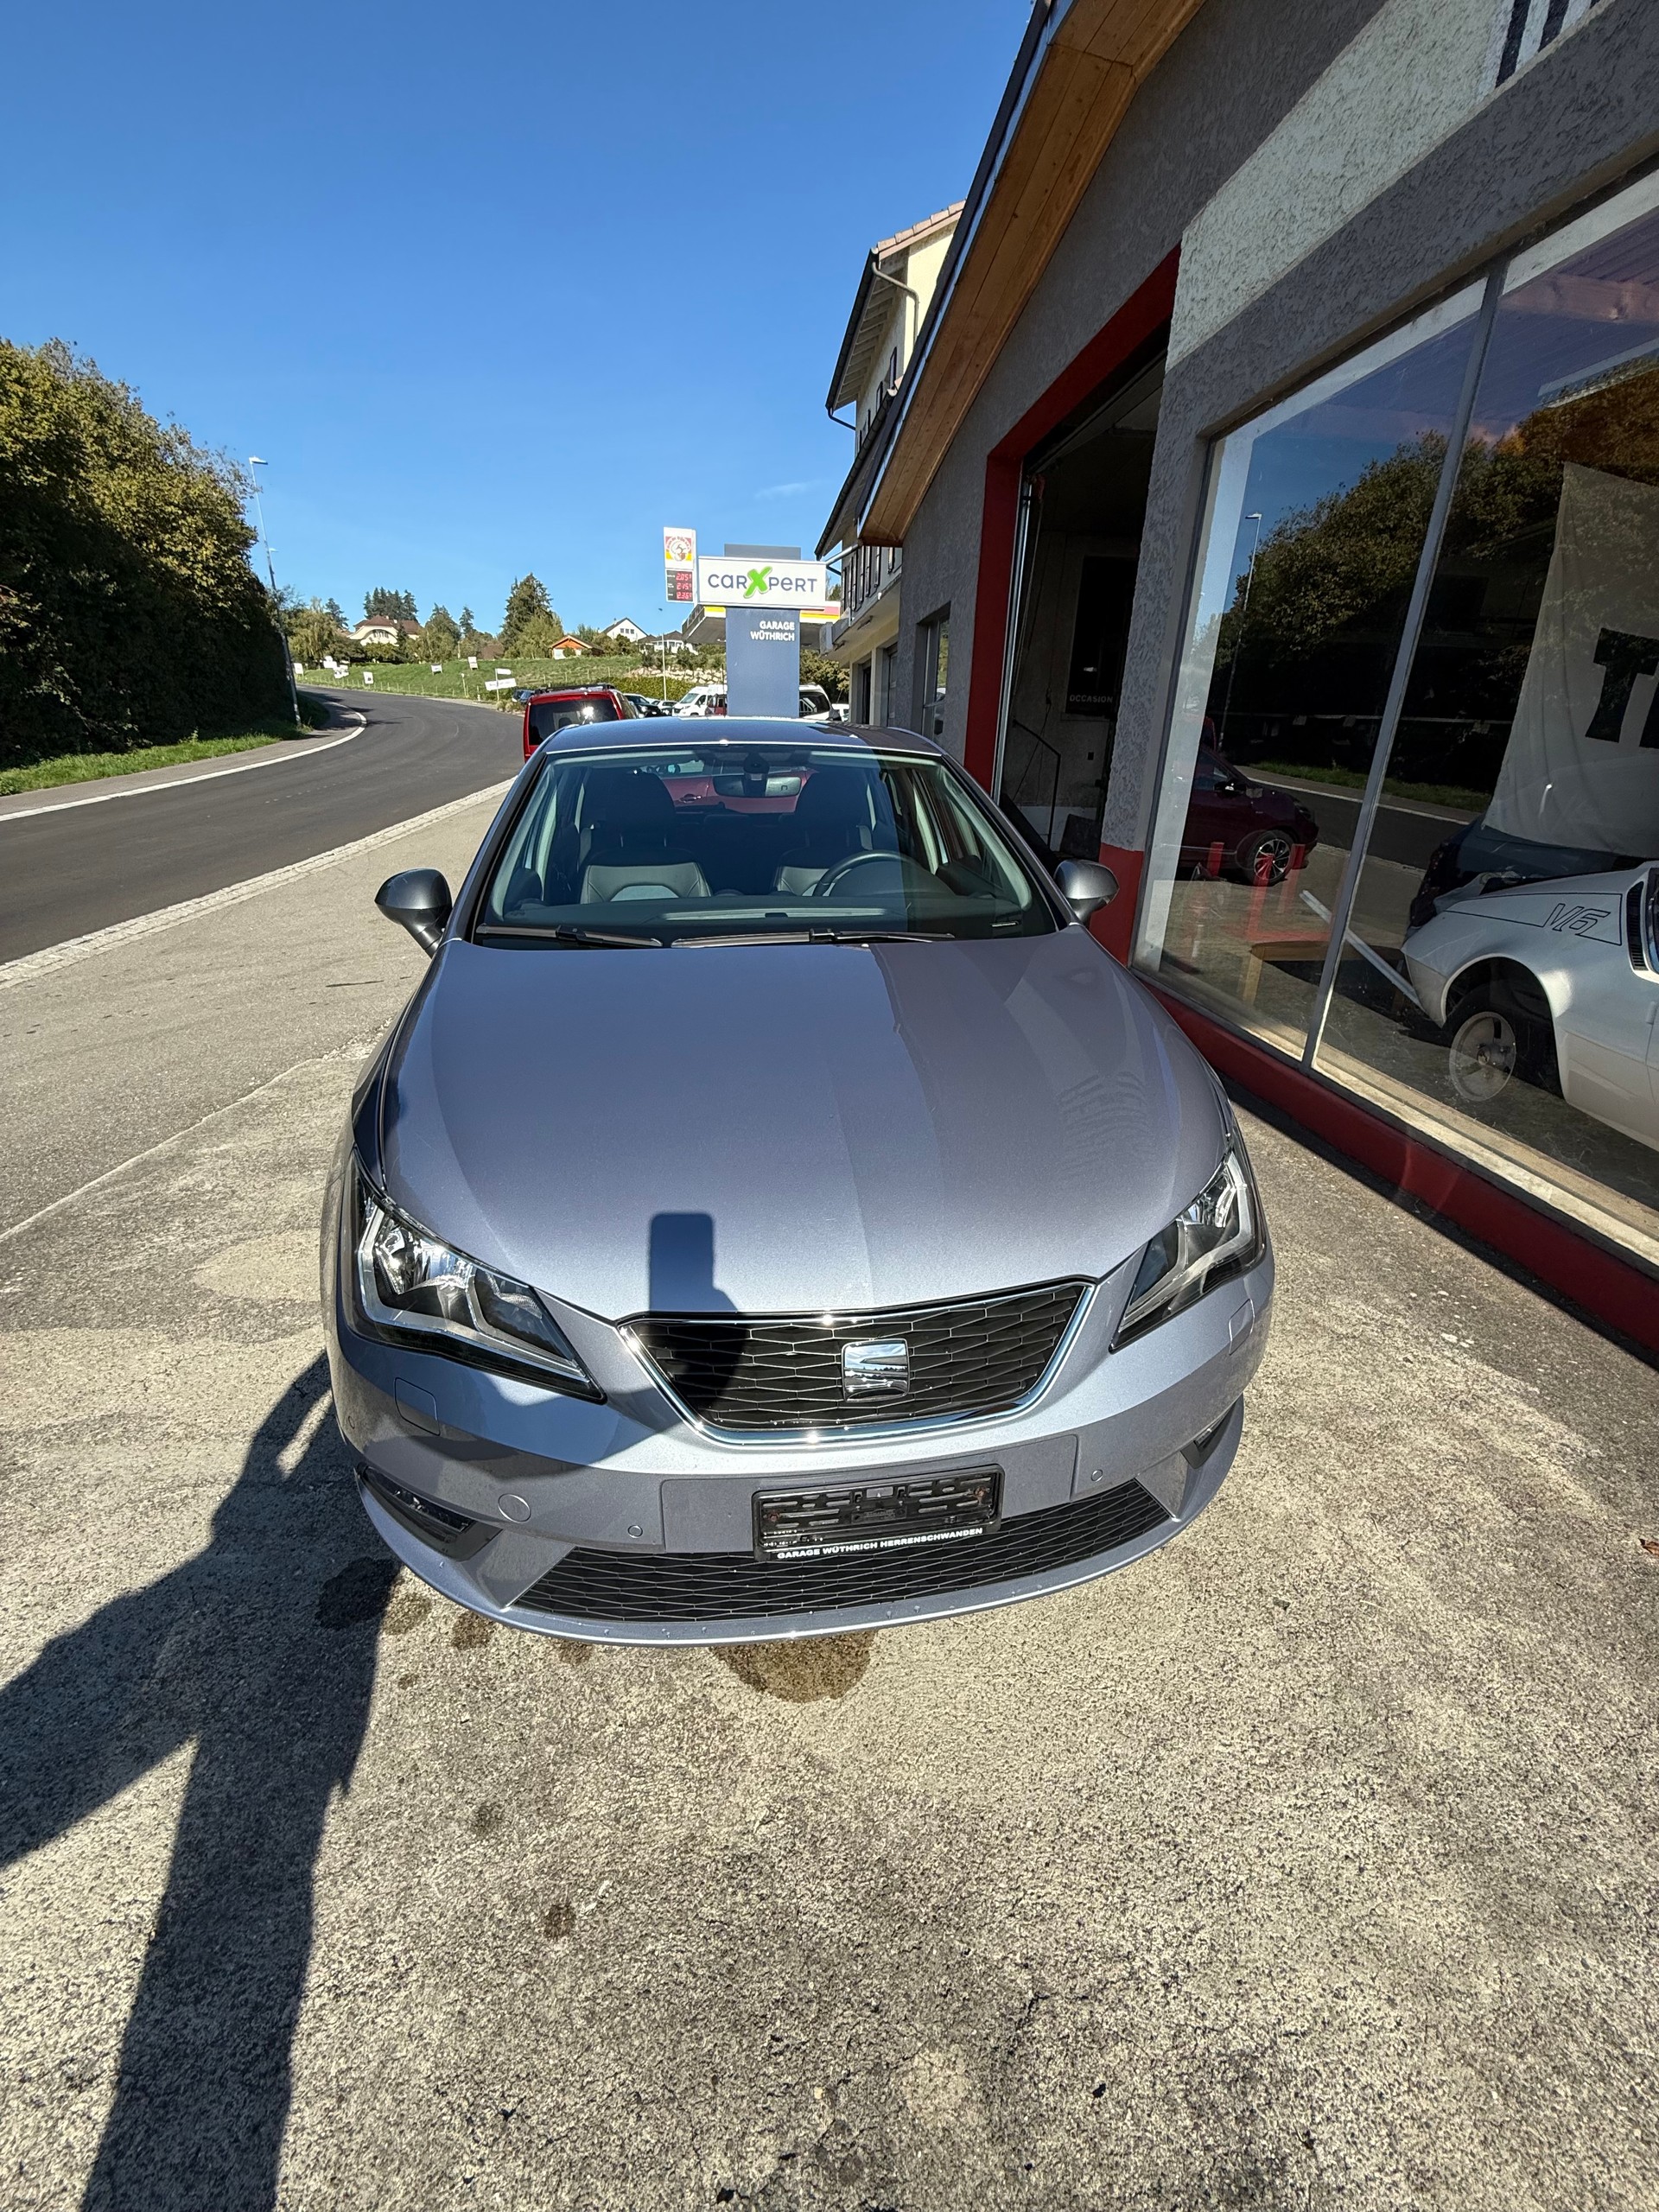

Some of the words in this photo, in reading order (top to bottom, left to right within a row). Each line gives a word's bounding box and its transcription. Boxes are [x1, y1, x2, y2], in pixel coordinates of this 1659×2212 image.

[760, 620, 795, 631] GARAGE
[750, 629, 795, 641] WÜTHRICH
[1069, 694, 1113, 703] OCCASION
[1542, 903, 1611, 936] V6
[777, 1548, 820, 1559] GARAGE
[822, 1541, 877, 1554] WÜTHRICH
[880, 1528, 983, 1548] HERRENSCHWANDEN
